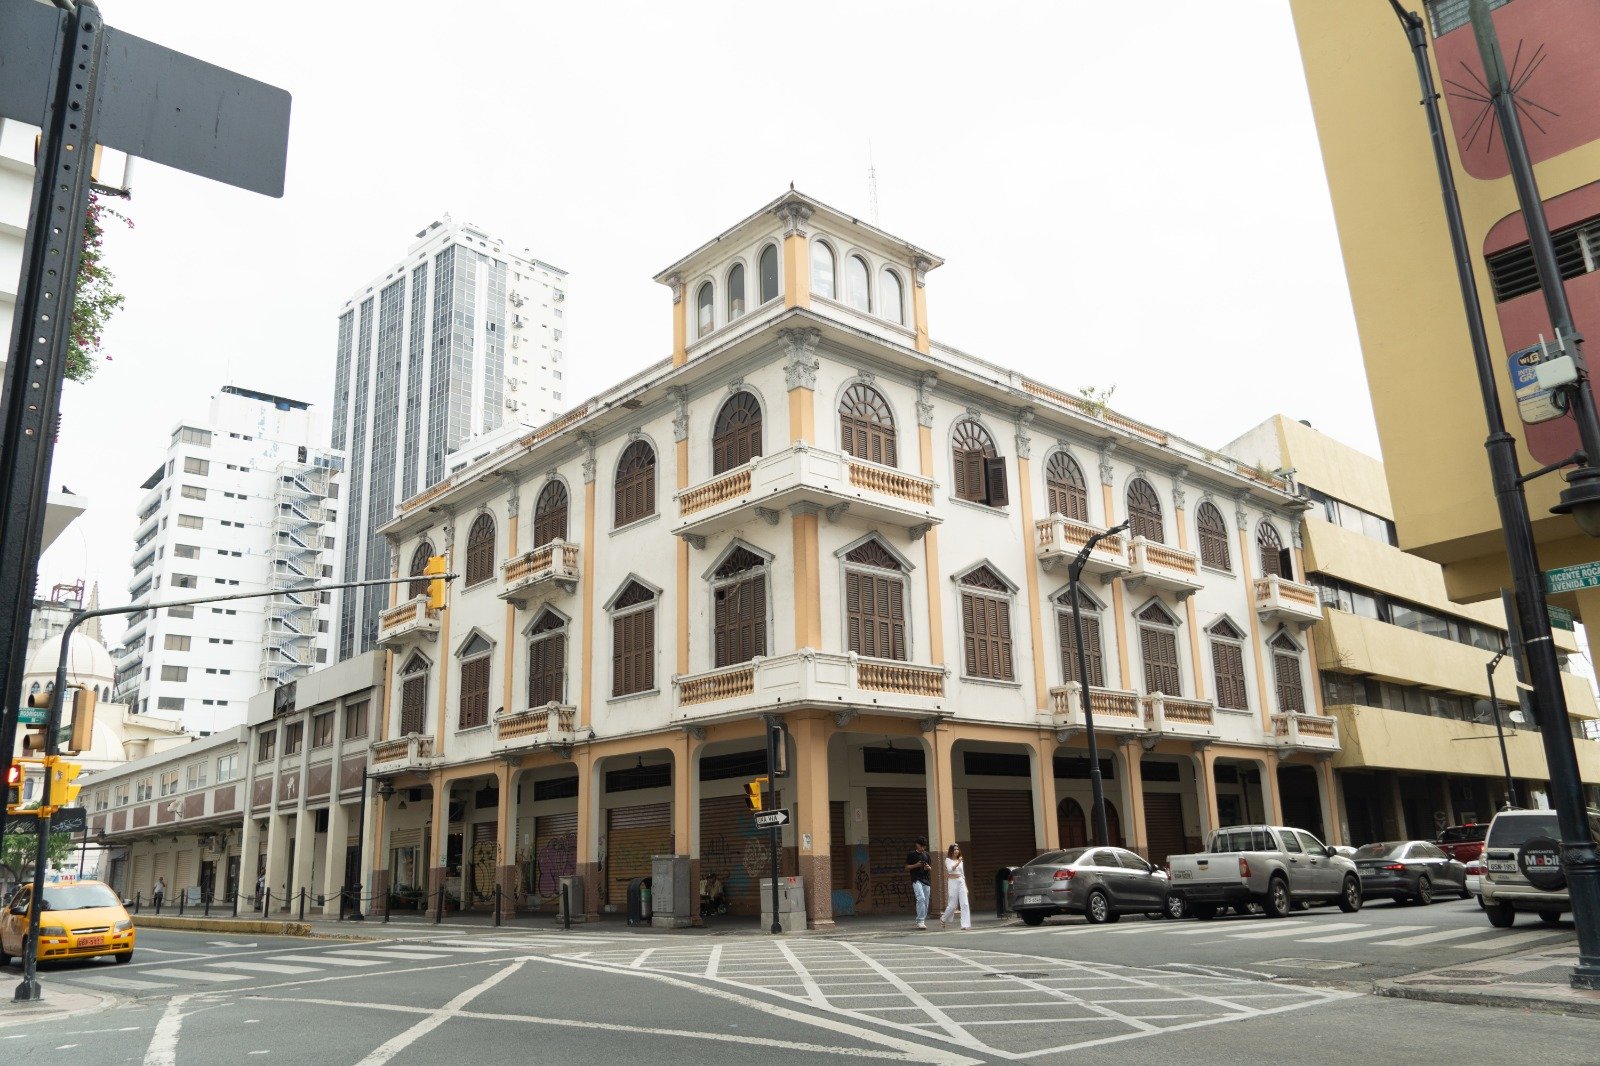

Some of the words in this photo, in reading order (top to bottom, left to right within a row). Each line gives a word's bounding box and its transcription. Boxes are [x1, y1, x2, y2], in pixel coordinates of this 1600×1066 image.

[1550, 571, 1581, 582] VICENTE
[1552, 579, 1584, 592] AVENIDA
[1588, 576, 1598, 586] 10
[1524, 855, 1560, 866] Mobil
